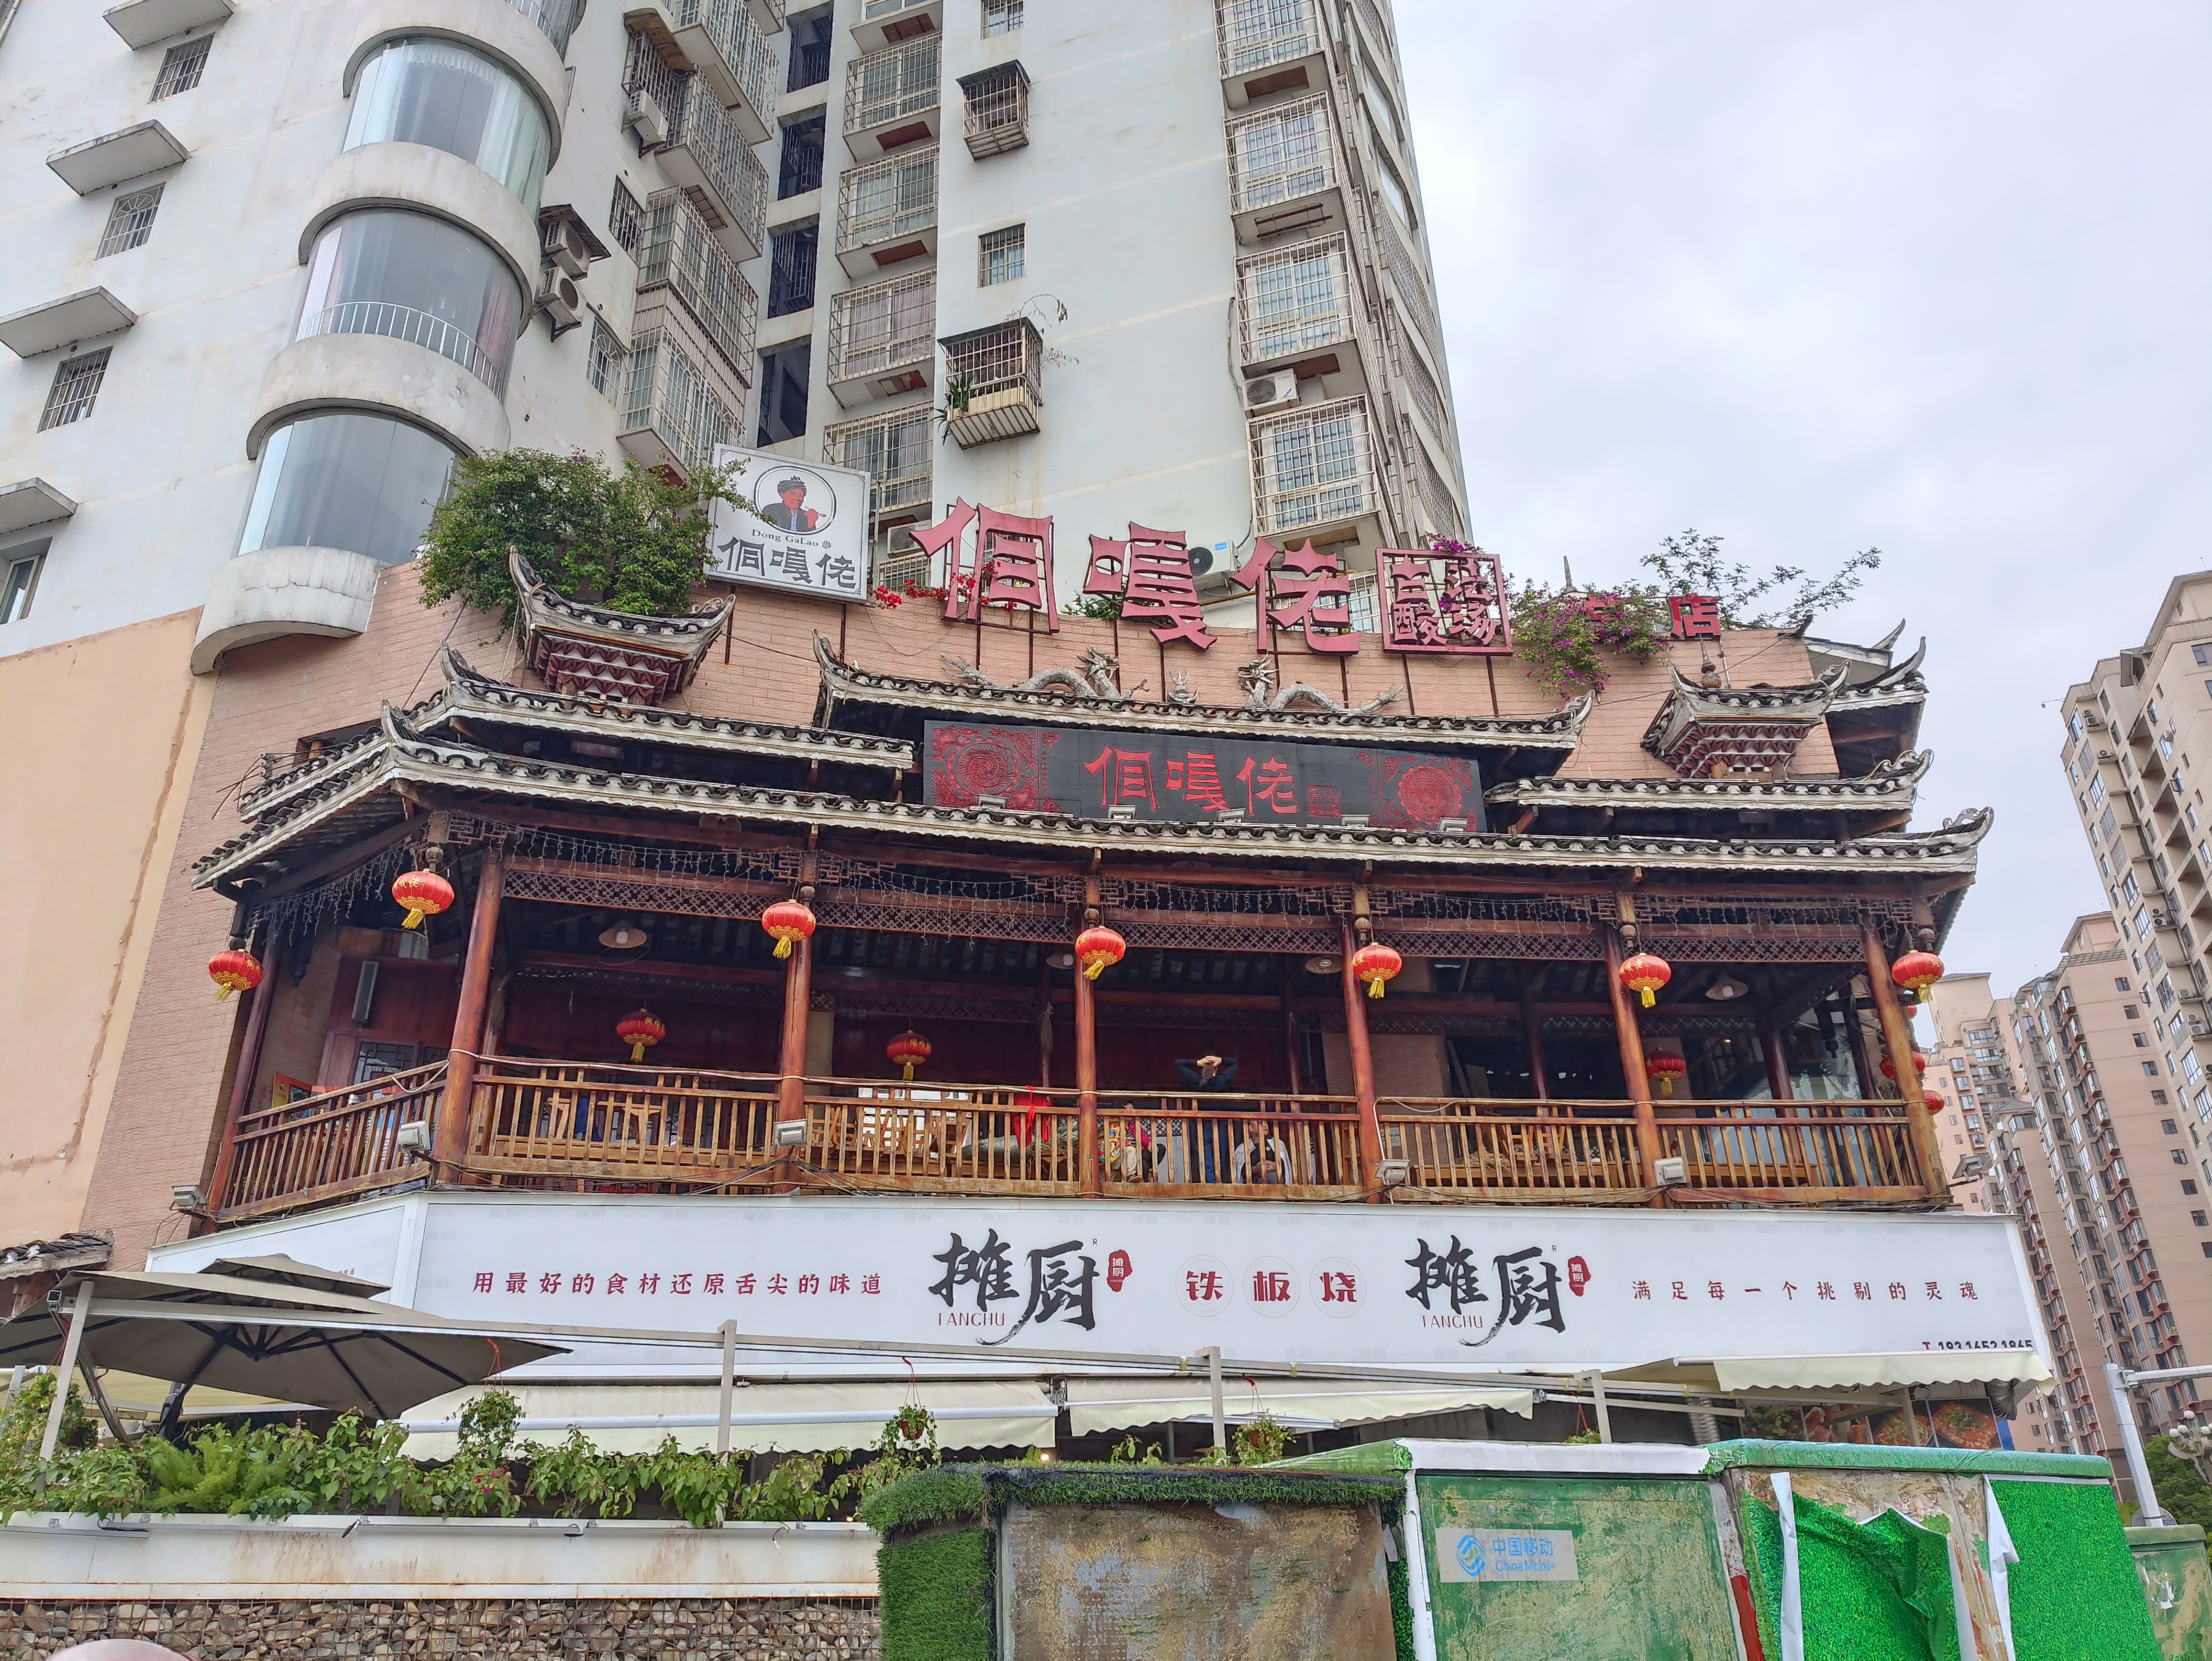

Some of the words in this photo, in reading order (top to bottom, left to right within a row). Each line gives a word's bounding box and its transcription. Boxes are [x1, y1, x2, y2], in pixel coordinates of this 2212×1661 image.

[752, 529, 781, 543] Dong
[785, 535, 818, 546] GaLao
[717, 537, 857, 589] 侗嘎佬
[1083, 743, 1299, 815] 侗嘎佬
[472, 1272, 883, 1296] 用最好的食材还原舌尖的味道
[928, 1228, 1099, 1346] 摊厨
[1186, 1271, 1357, 1303] 铁板烧
[1405, 1235, 1565, 1347] 摊厨
[1631, 1281, 1979, 1301] 满足每一个挑剔的灵魂
[1493, 1537, 1553, 1556] 中国移动
[1495, 1560, 1523, 1572] China
[1524, 1559, 1555, 1572] Mobile
